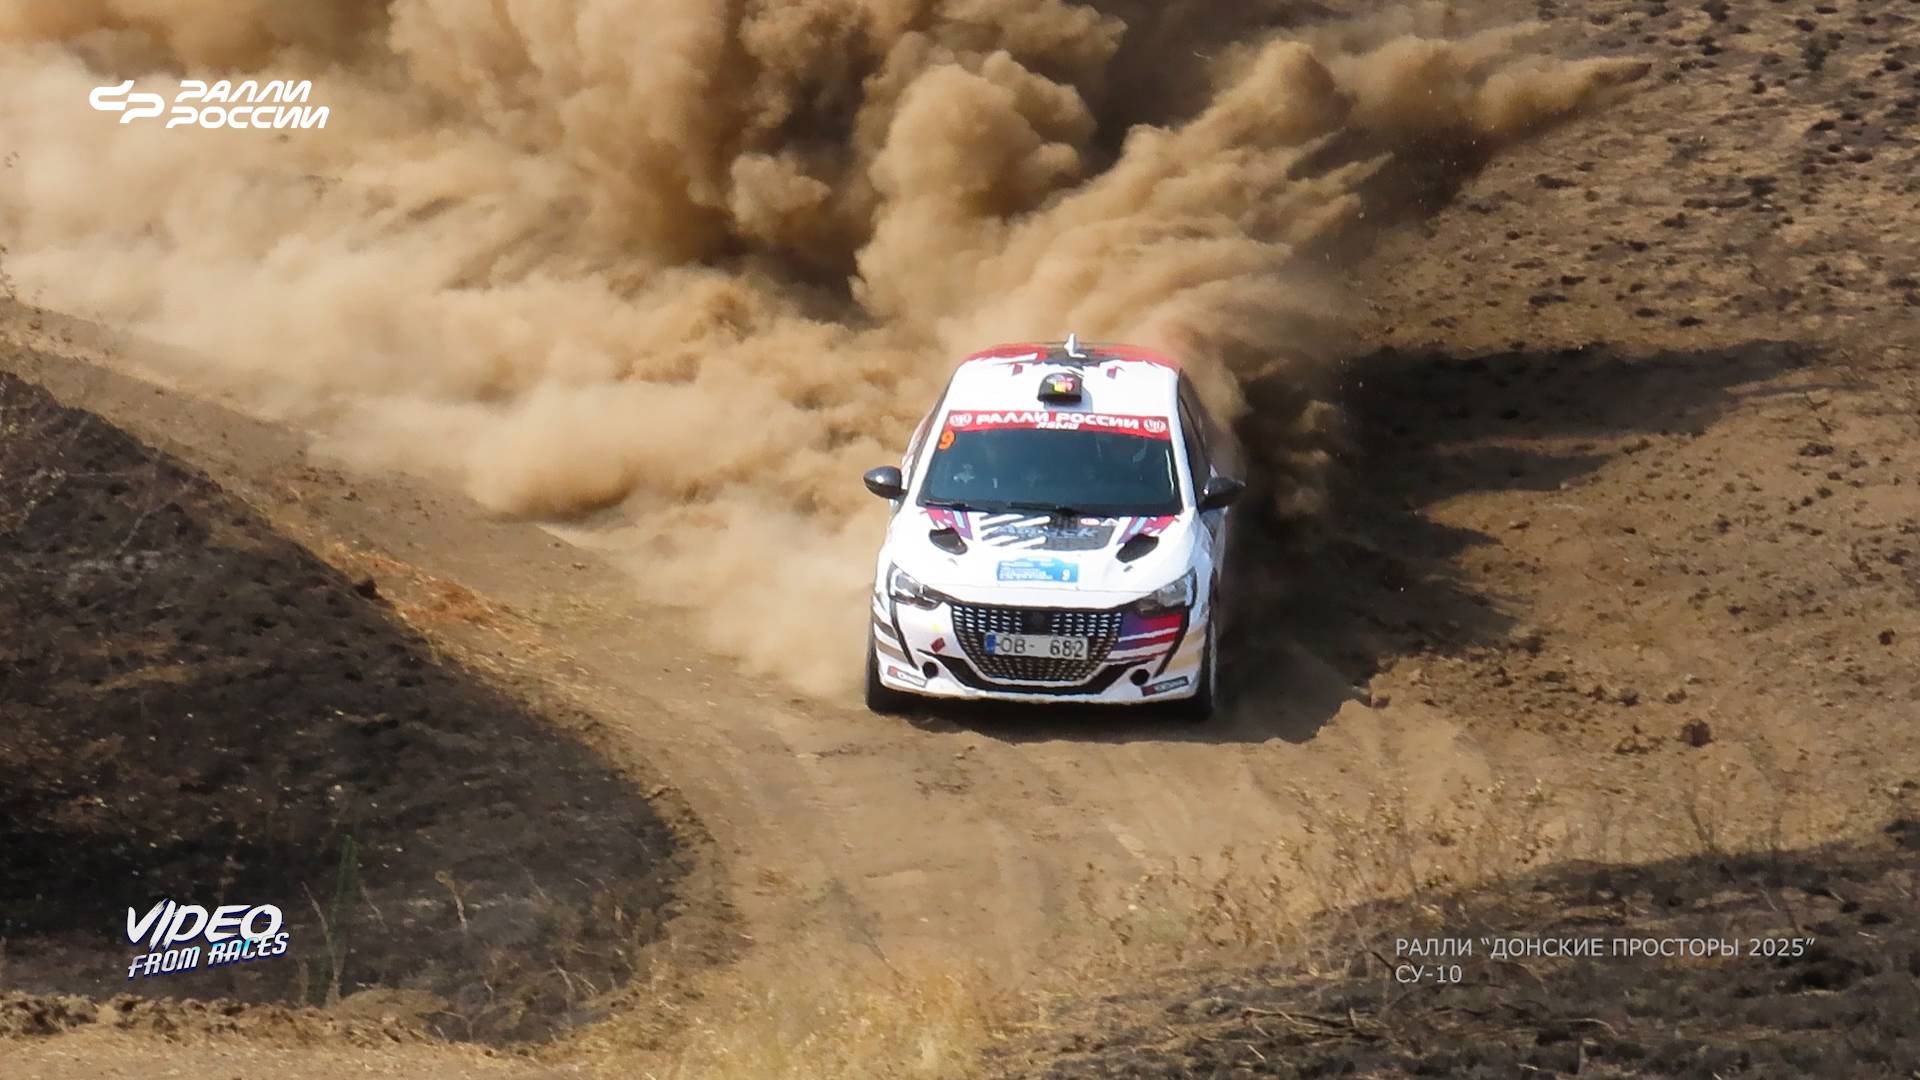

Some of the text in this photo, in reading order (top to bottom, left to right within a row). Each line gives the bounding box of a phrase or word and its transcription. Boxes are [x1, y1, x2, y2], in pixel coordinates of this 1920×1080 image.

[976, 411, 1139, 429] РАЛЛИ РОССИИ
[938, 430, 955, 449] 9
[1061, 568, 1071, 581] 9
[1049, 639, 1084, 658] 682
